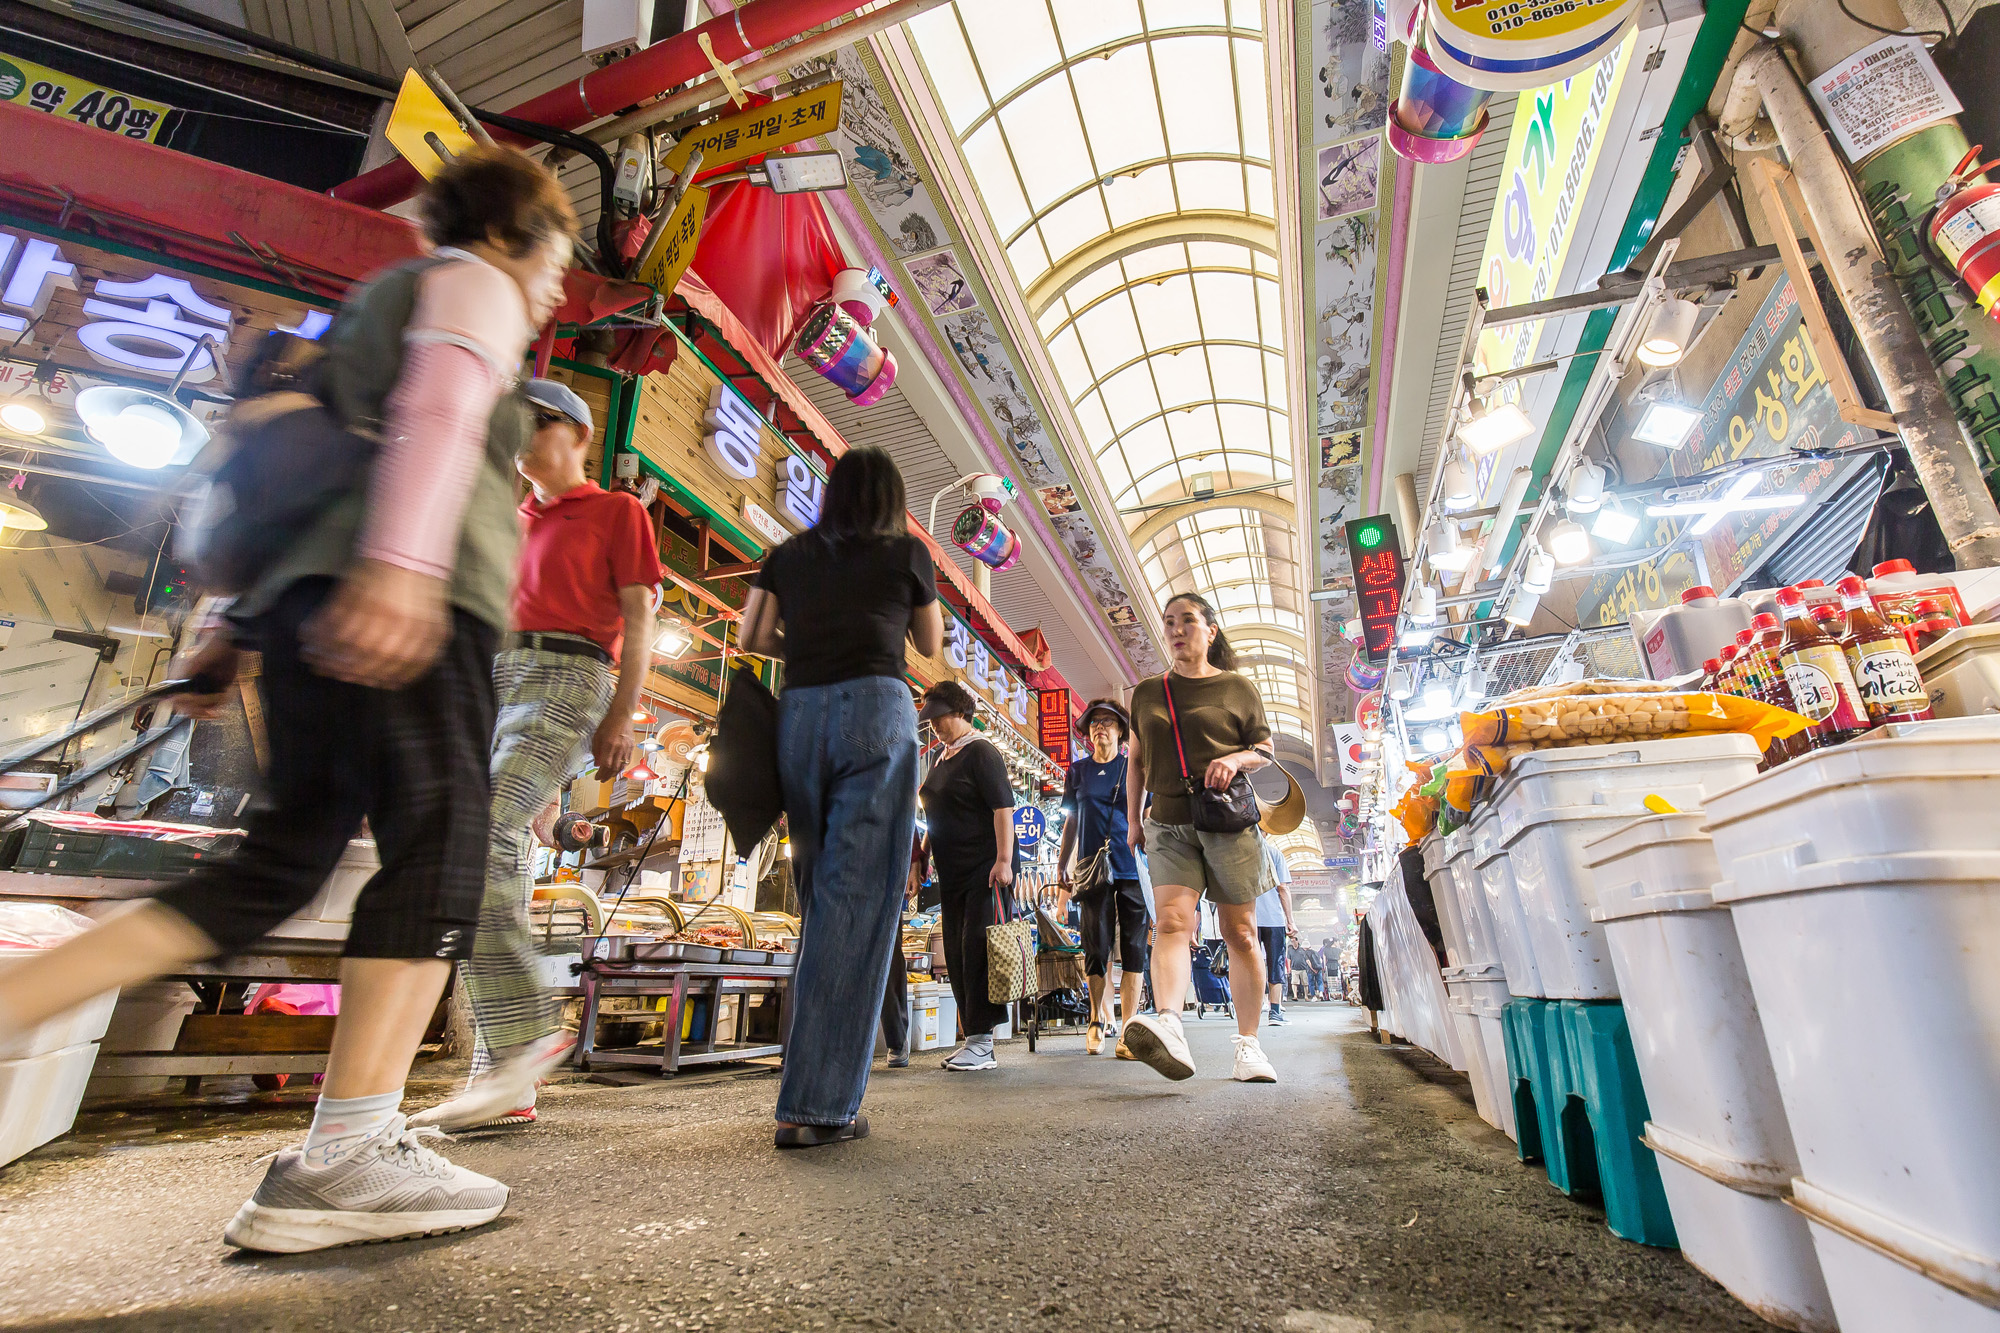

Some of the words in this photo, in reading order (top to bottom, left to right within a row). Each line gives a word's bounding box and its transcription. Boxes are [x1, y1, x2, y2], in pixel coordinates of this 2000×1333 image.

[1831, 58, 1918, 107] 010-9469-0588
[1703, 390, 1727, 434] 오징어
[1739, 324, 1769, 376] 건어물
[1014, 824, 1041, 839] 문어
[1021, 808, 1035, 823] 산
